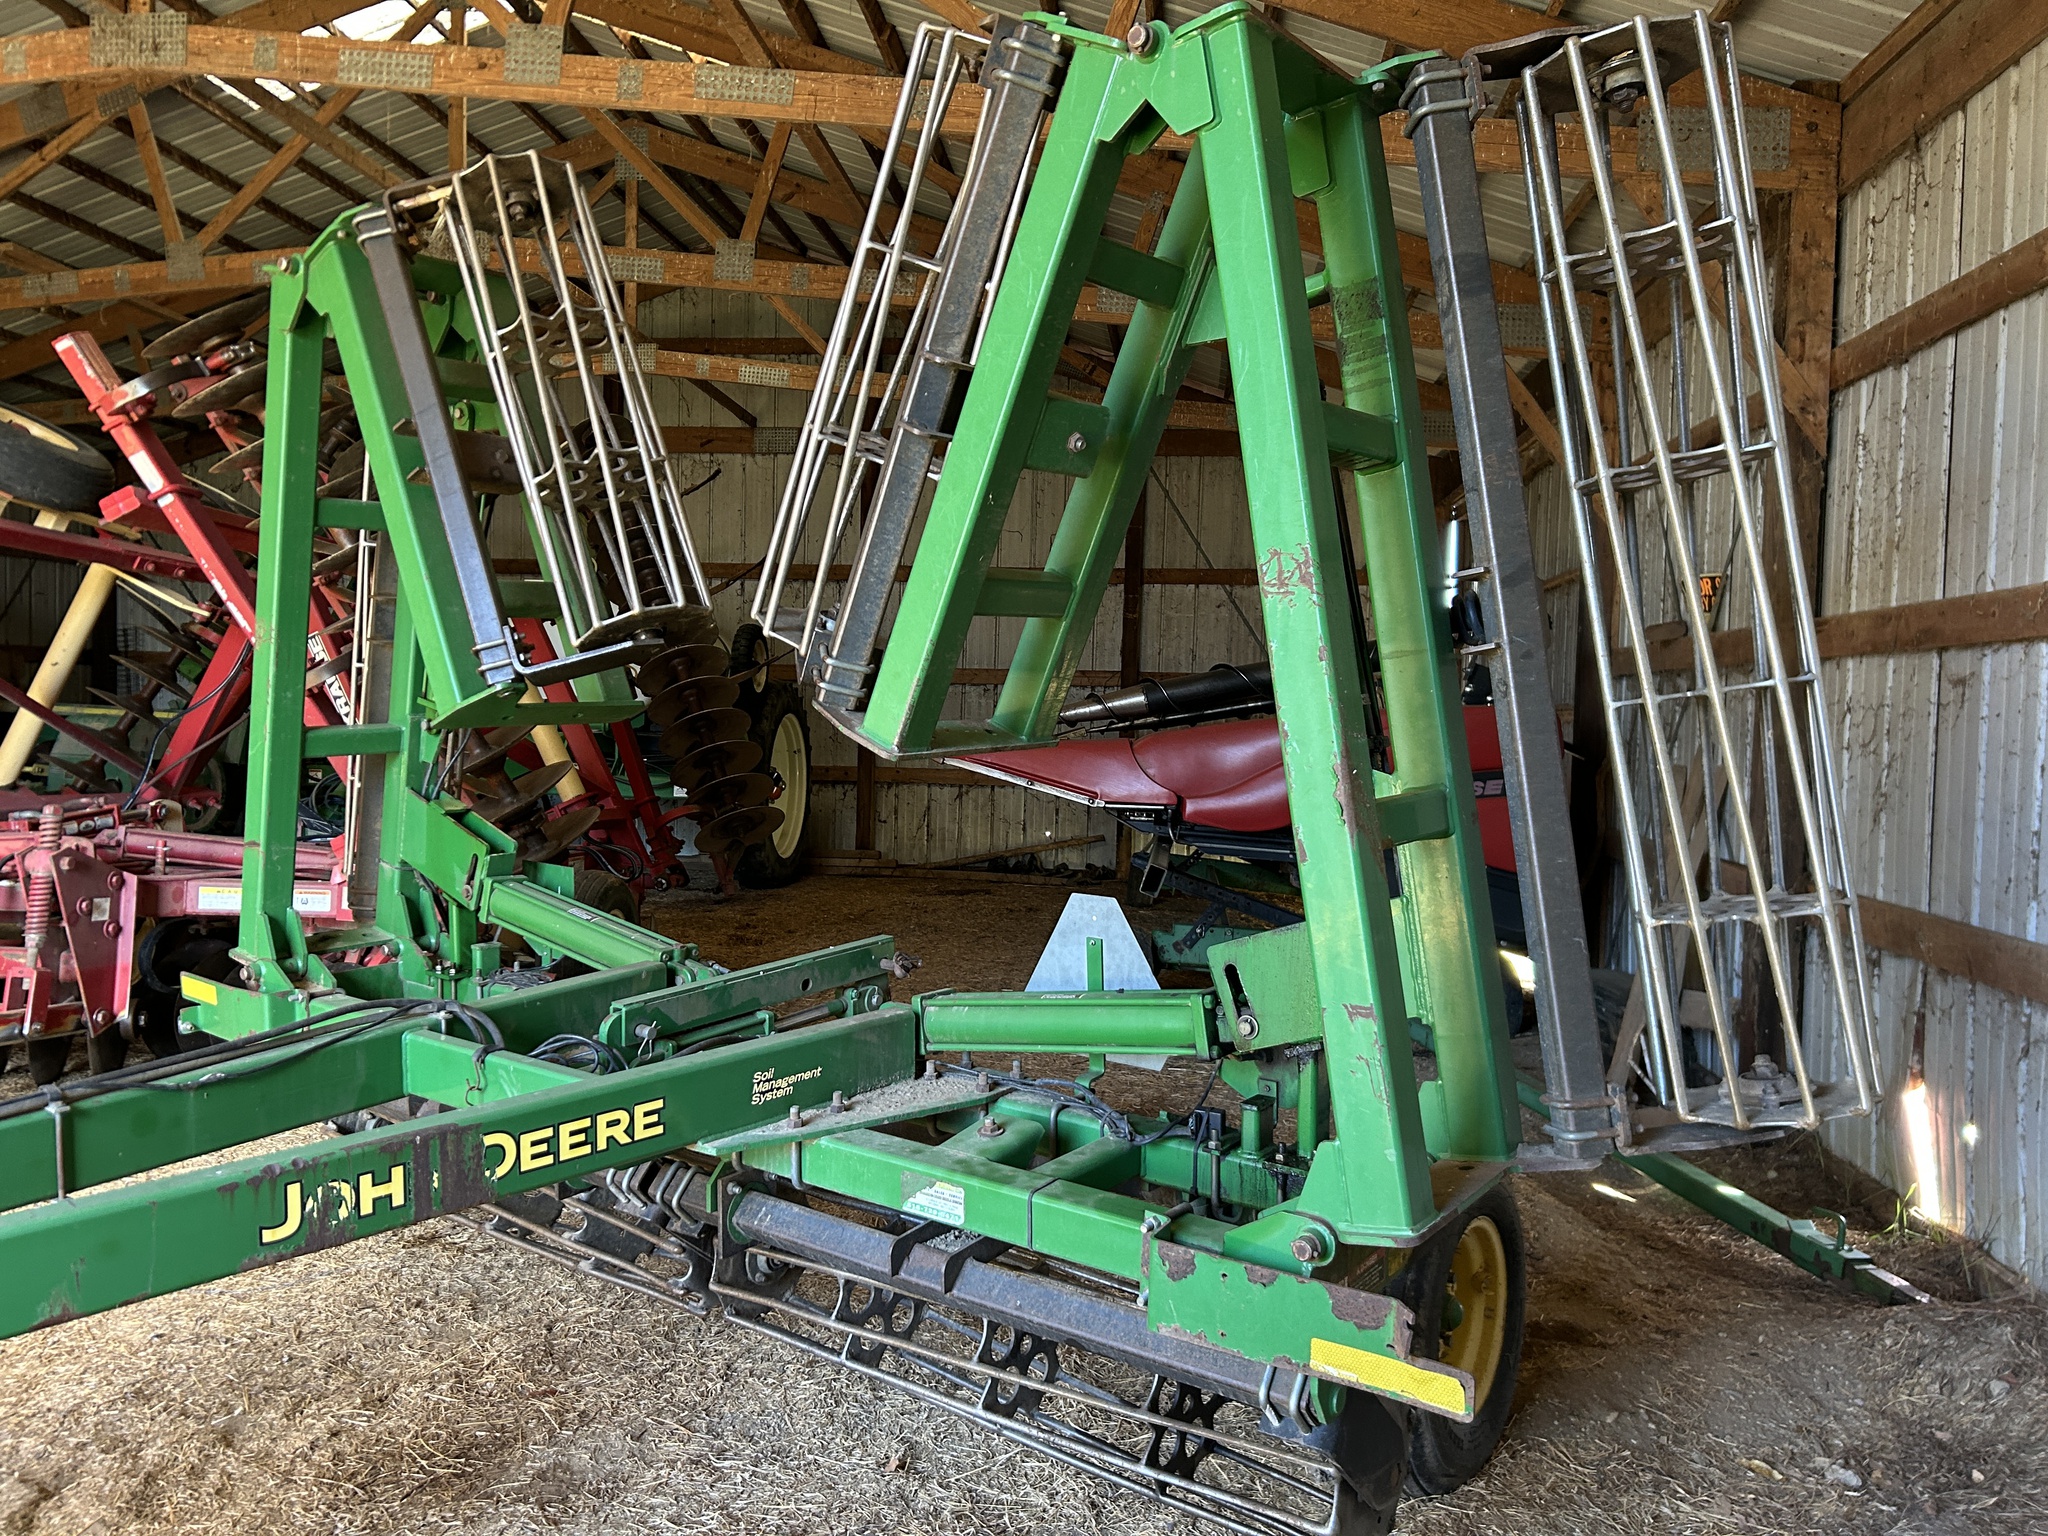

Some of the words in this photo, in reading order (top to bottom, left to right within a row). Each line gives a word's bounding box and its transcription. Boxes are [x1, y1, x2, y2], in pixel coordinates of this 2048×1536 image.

[752, 1067, 775, 1083] Soil
[752, 1066, 823, 1094] Management
[751, 1085, 794, 1105] System
[482, 1096, 666, 1181] DEERE
